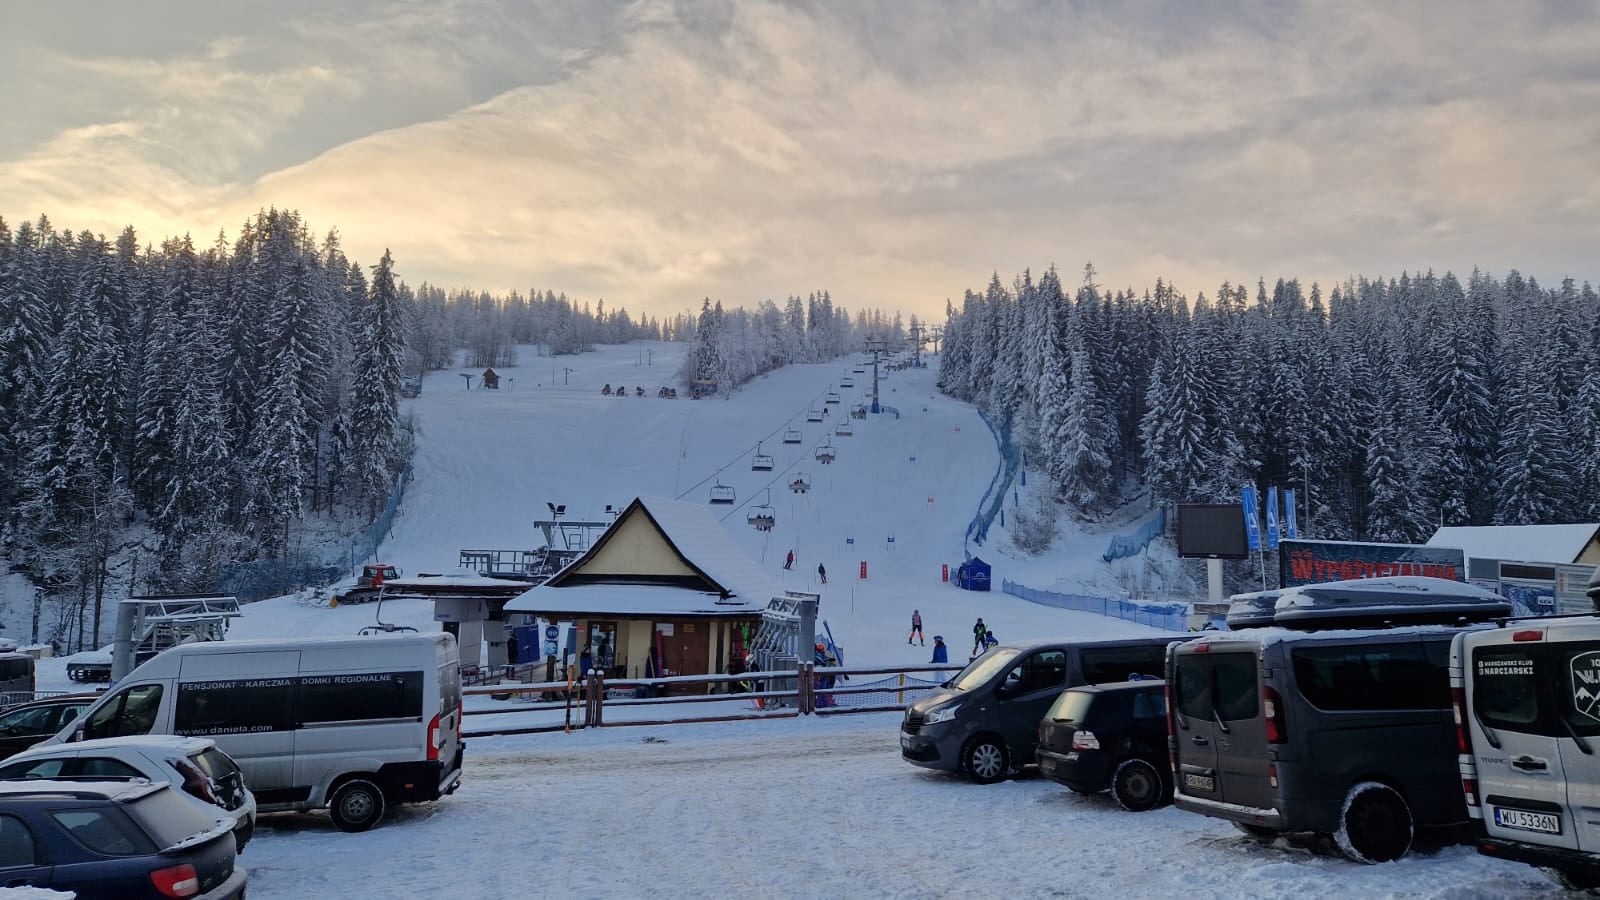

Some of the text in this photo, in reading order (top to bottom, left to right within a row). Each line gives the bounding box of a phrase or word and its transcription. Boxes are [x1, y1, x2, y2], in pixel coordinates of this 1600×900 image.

[1518, 659, 1534, 667] KLUB
[1484, 666, 1534, 675] NARCIARSKI
[181, 681, 237, 691] PENSJONAT
[245, 679, 291, 688] KARCZMA
[301, 677, 331, 685] DOMKI
[334, 673, 392, 684] REGIONALNE
[1480, 756, 1507, 765] TRAFIC
[1502, 811, 1556, 830] WU 5336N
